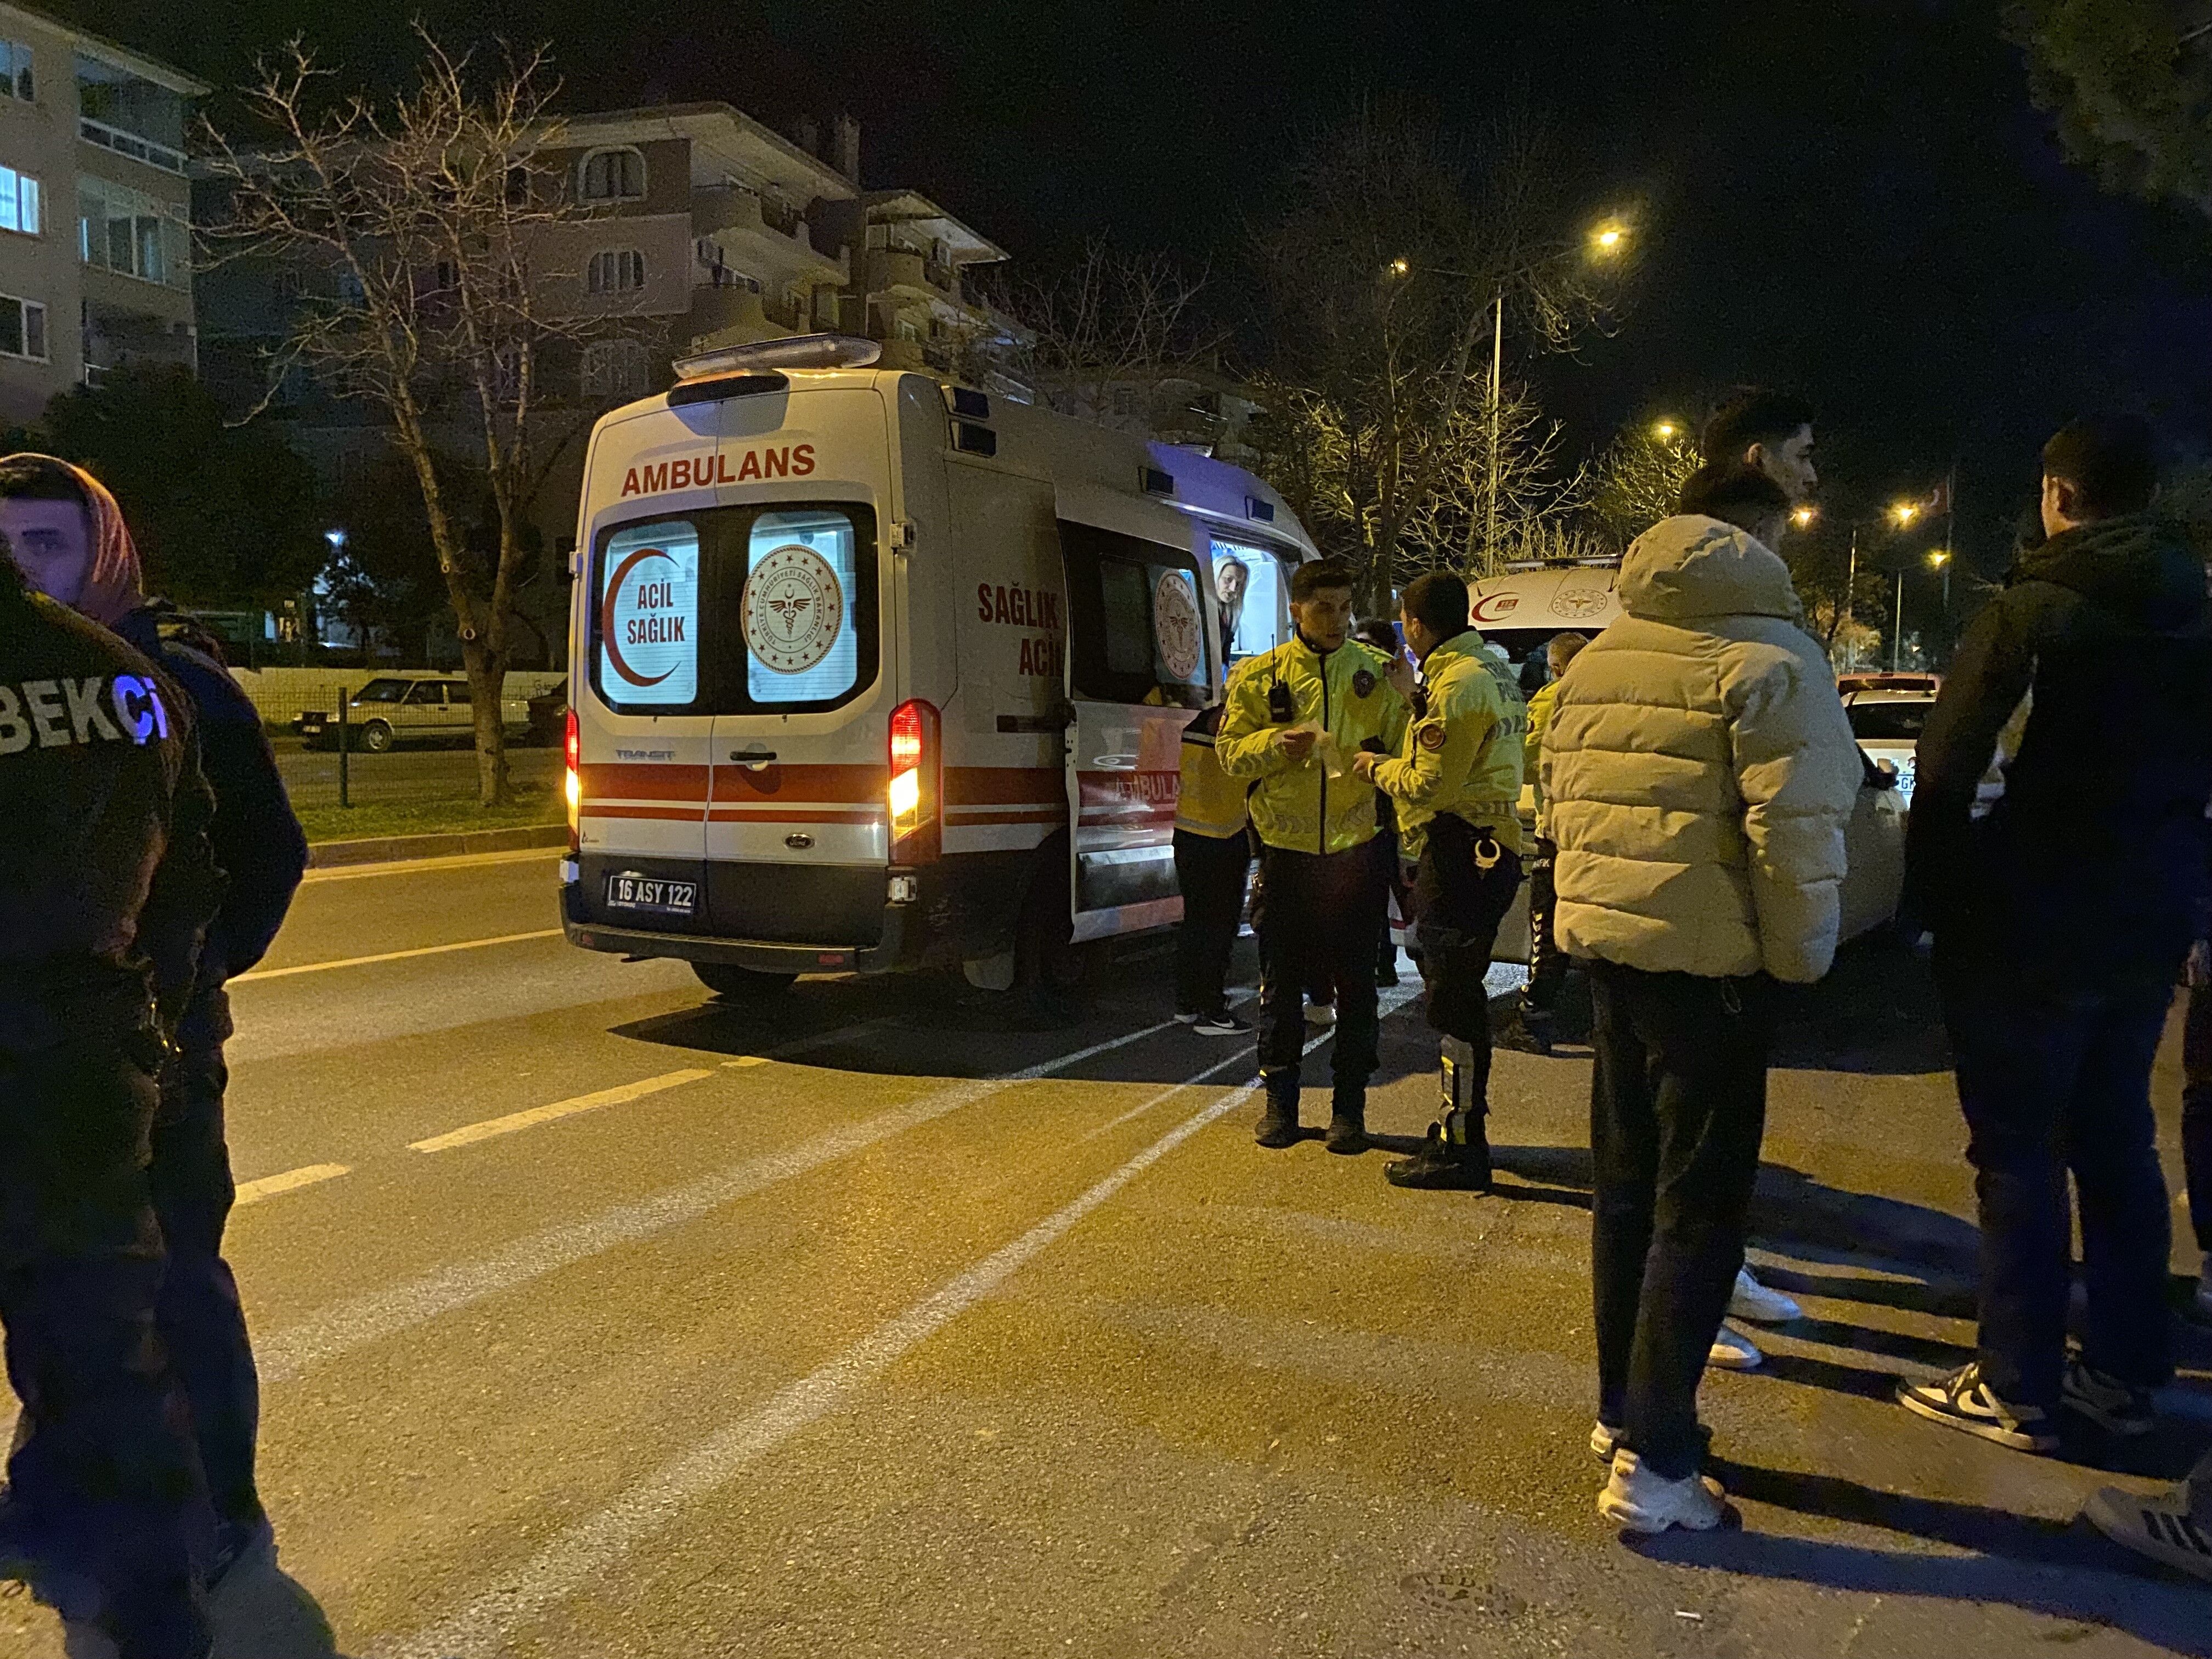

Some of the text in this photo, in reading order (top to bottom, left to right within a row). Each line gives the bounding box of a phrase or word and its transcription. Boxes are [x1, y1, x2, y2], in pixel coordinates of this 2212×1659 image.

[621, 444, 815, 497] AMBULANS
[637, 578, 674, 610] ACİL
[759, 613, 776, 645] TÜRKİYE
[797, 571, 819, 595] SAĞLIK
[978, 581, 1059, 630] SAĞLIK
[627, 612, 685, 645] SAĞLIK
[0, 675, 167, 755] BEKÇİ
[619, 879, 693, 907] 16 ASY 122
